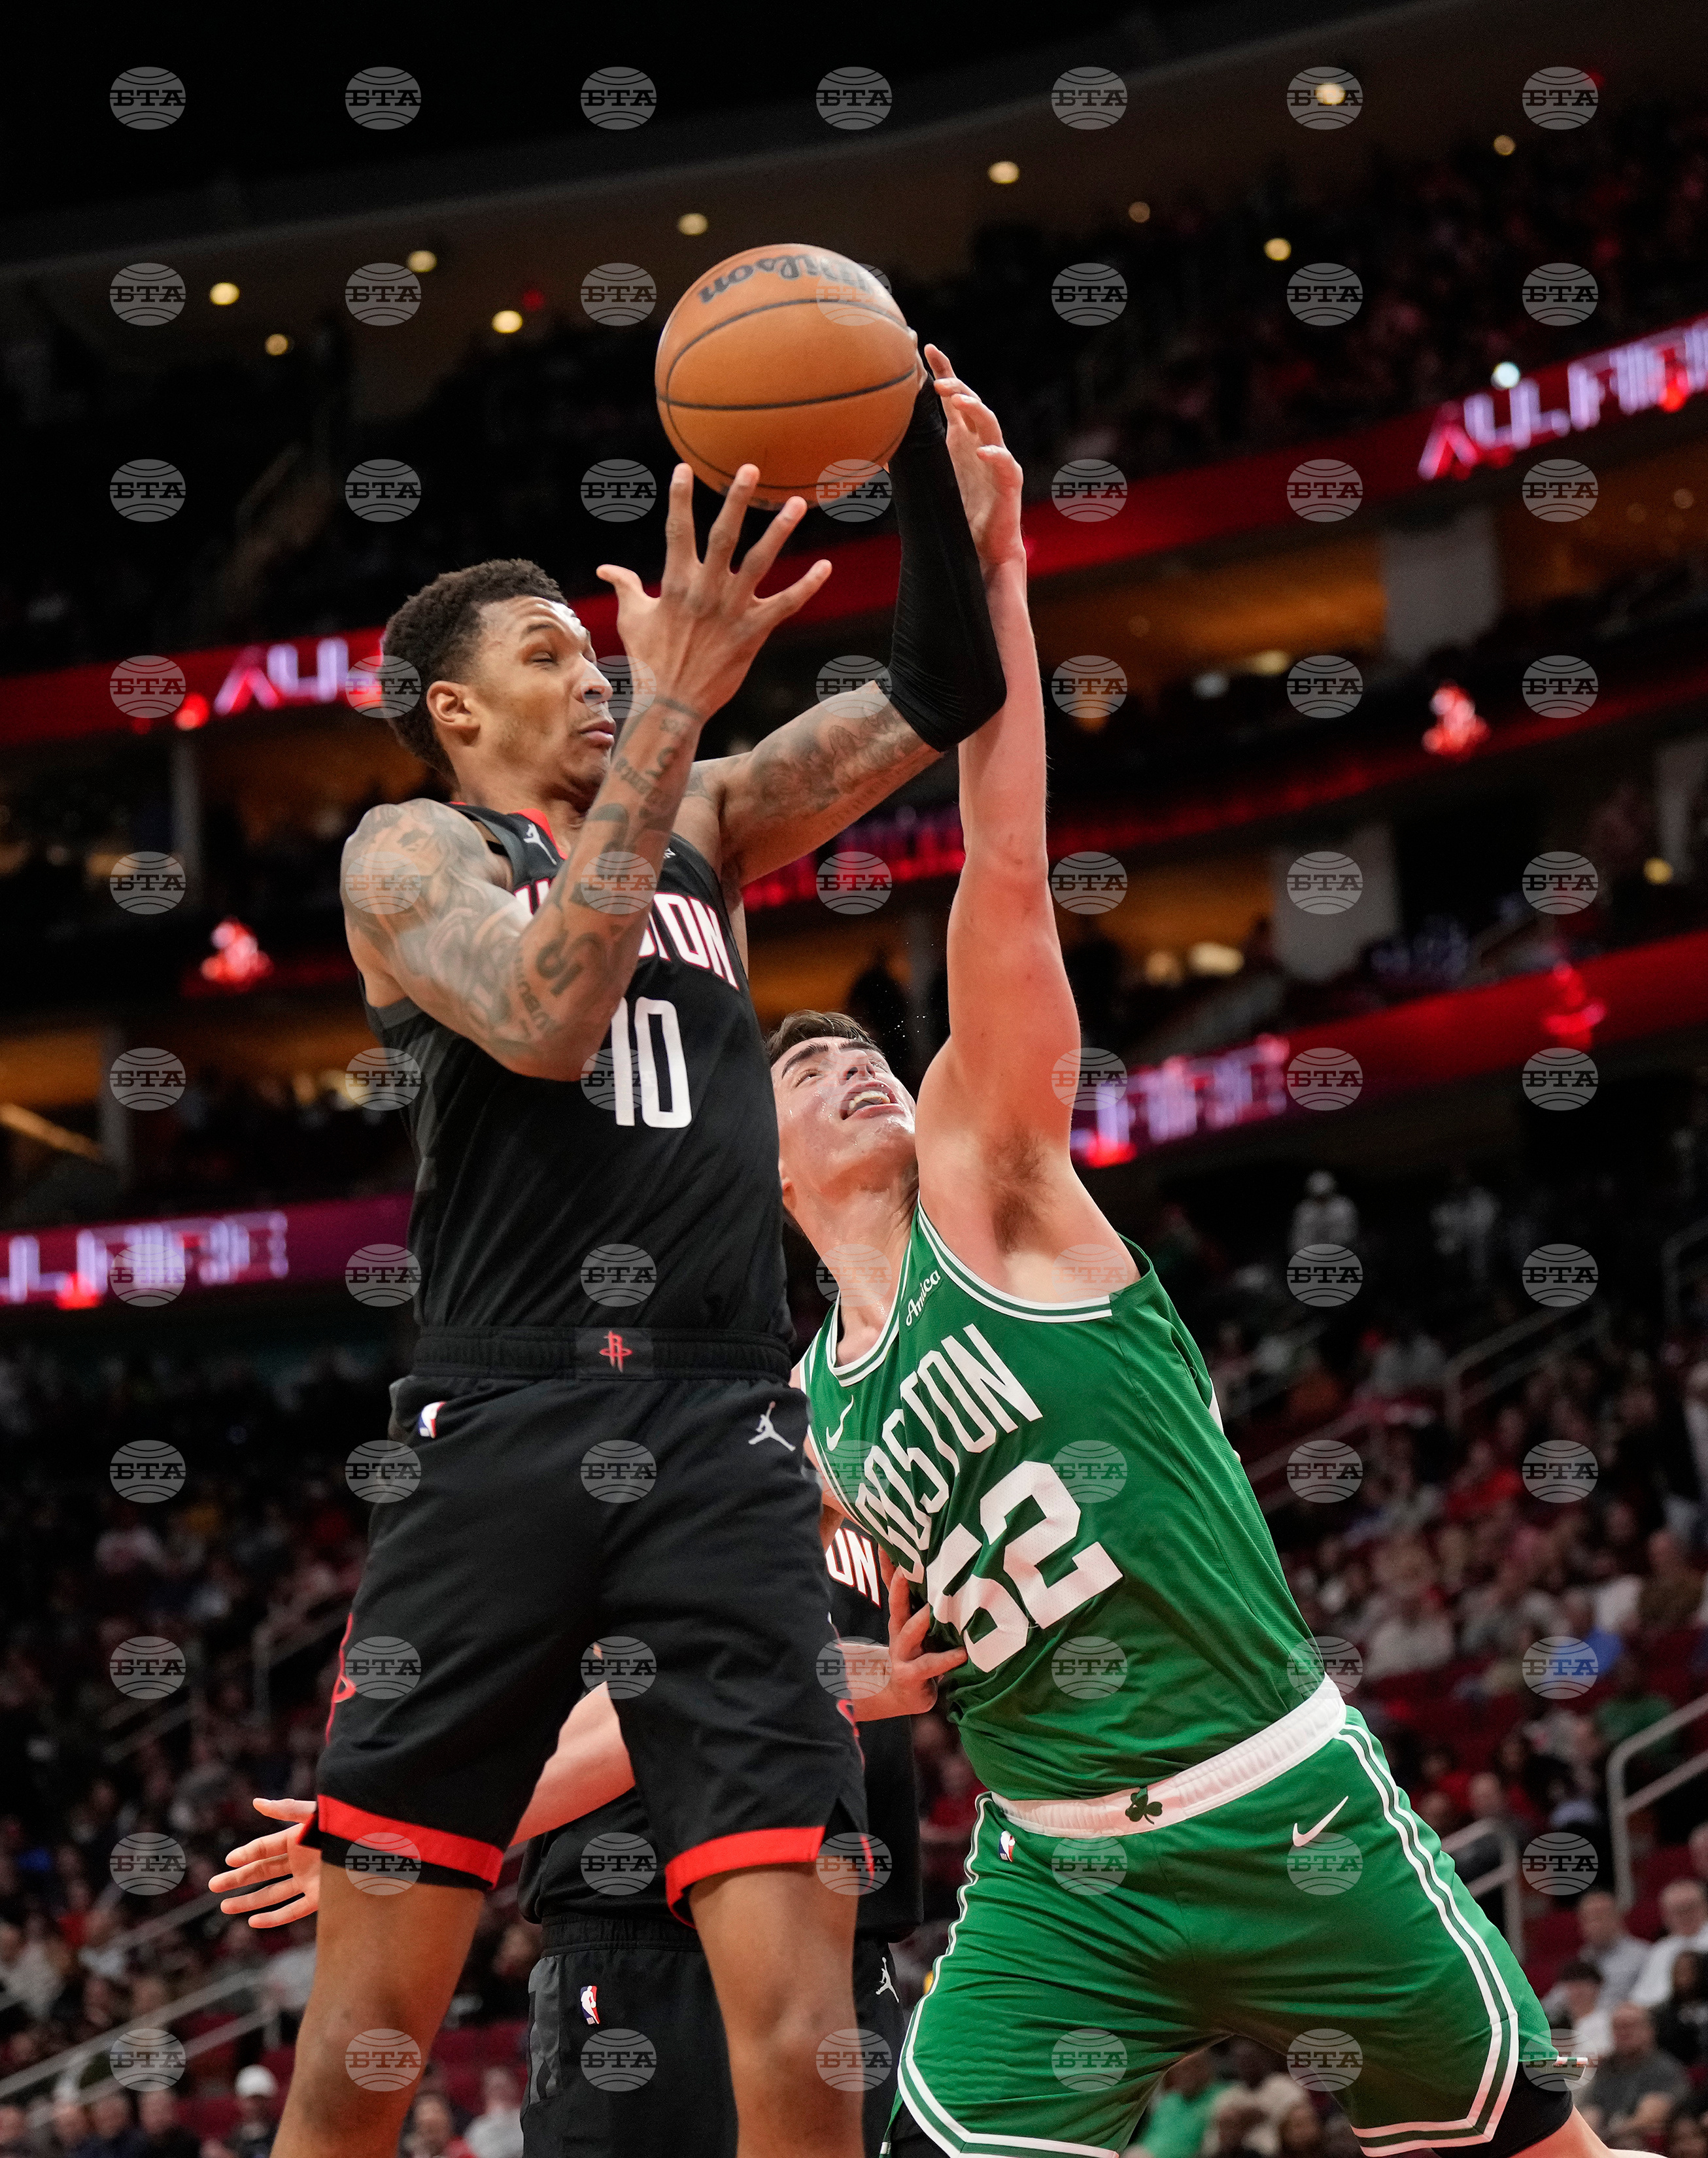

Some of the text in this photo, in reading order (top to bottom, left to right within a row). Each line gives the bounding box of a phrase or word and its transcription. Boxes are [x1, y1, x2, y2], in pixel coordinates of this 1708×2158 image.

[611, 996, 692, 1129] 10
[906, 1270, 941, 1326] Amica
[855, 1324, 1043, 1583] BOSTON
[927, 1460, 1123, 1673] 52
